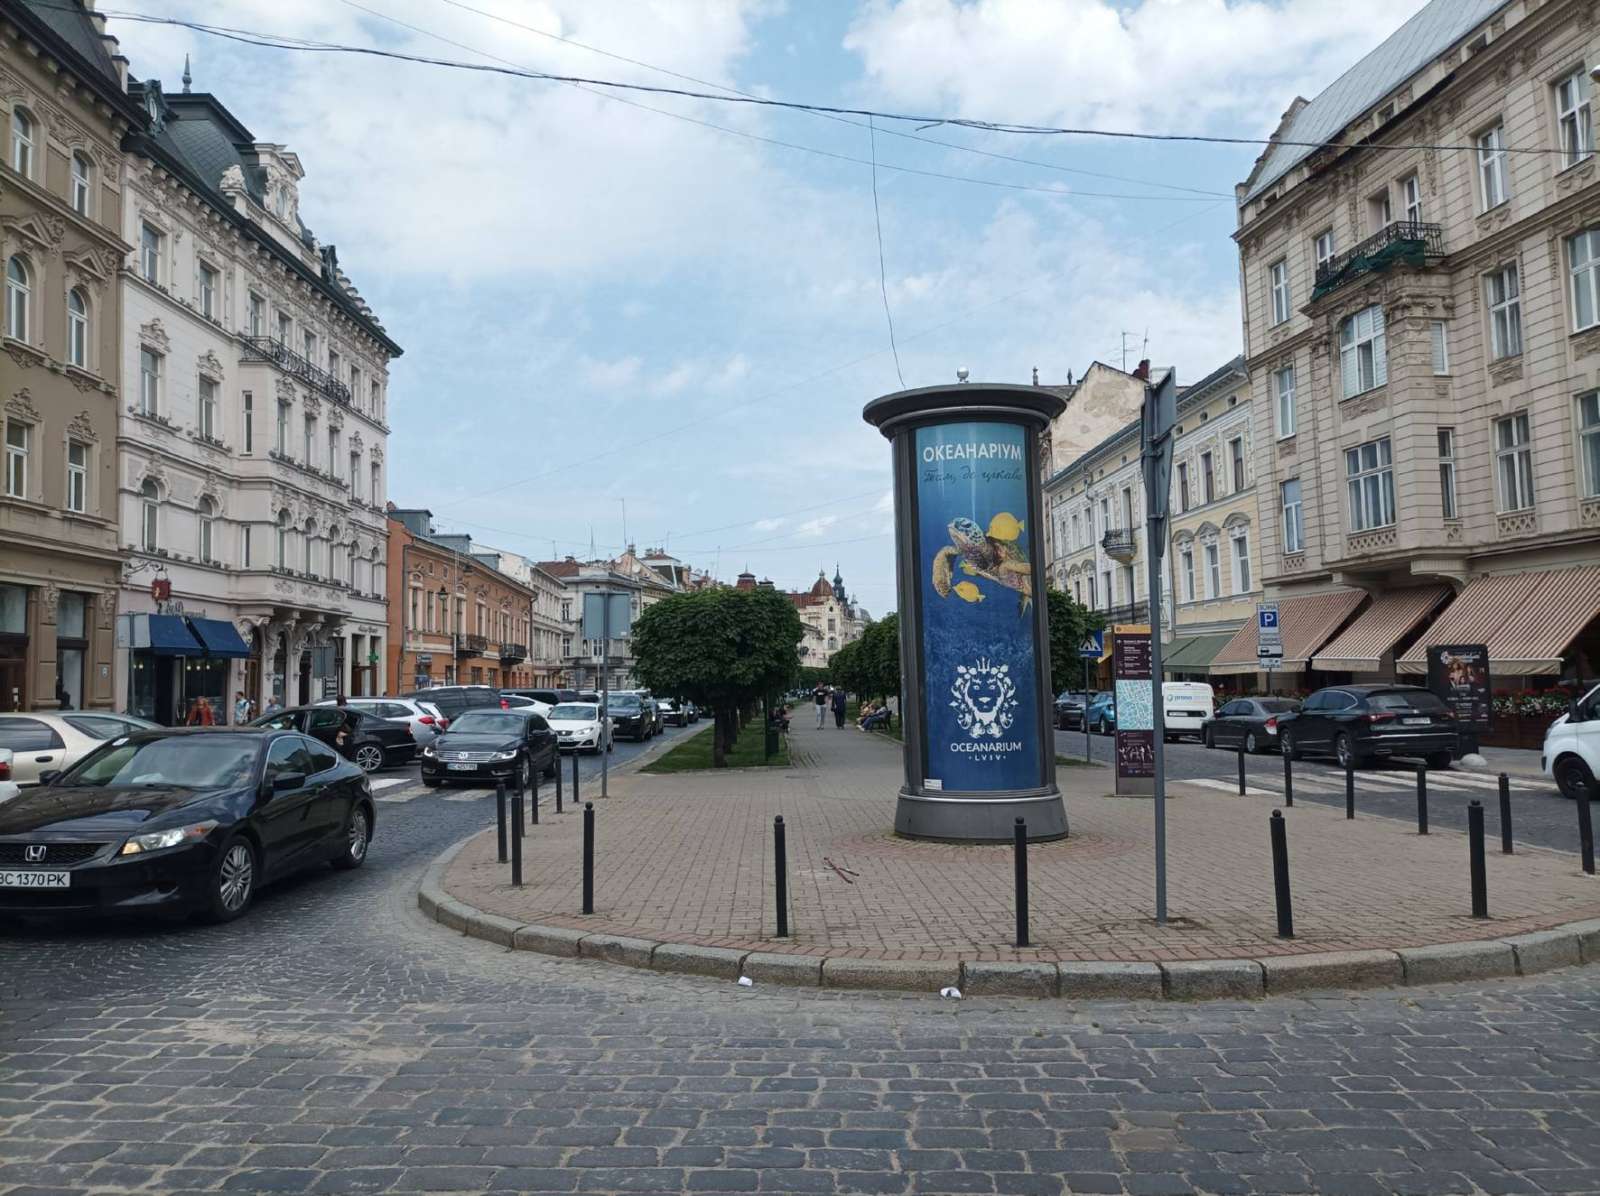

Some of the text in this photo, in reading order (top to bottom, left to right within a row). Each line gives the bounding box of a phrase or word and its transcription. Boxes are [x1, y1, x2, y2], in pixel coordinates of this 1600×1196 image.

[923, 443, 1022, 463] ОКЕАНАРІУМ
[950, 742, 1022, 752] OCEANARIUM
[16, 873, 45, 886] 1370
[47, 873, 66, 886] PK
